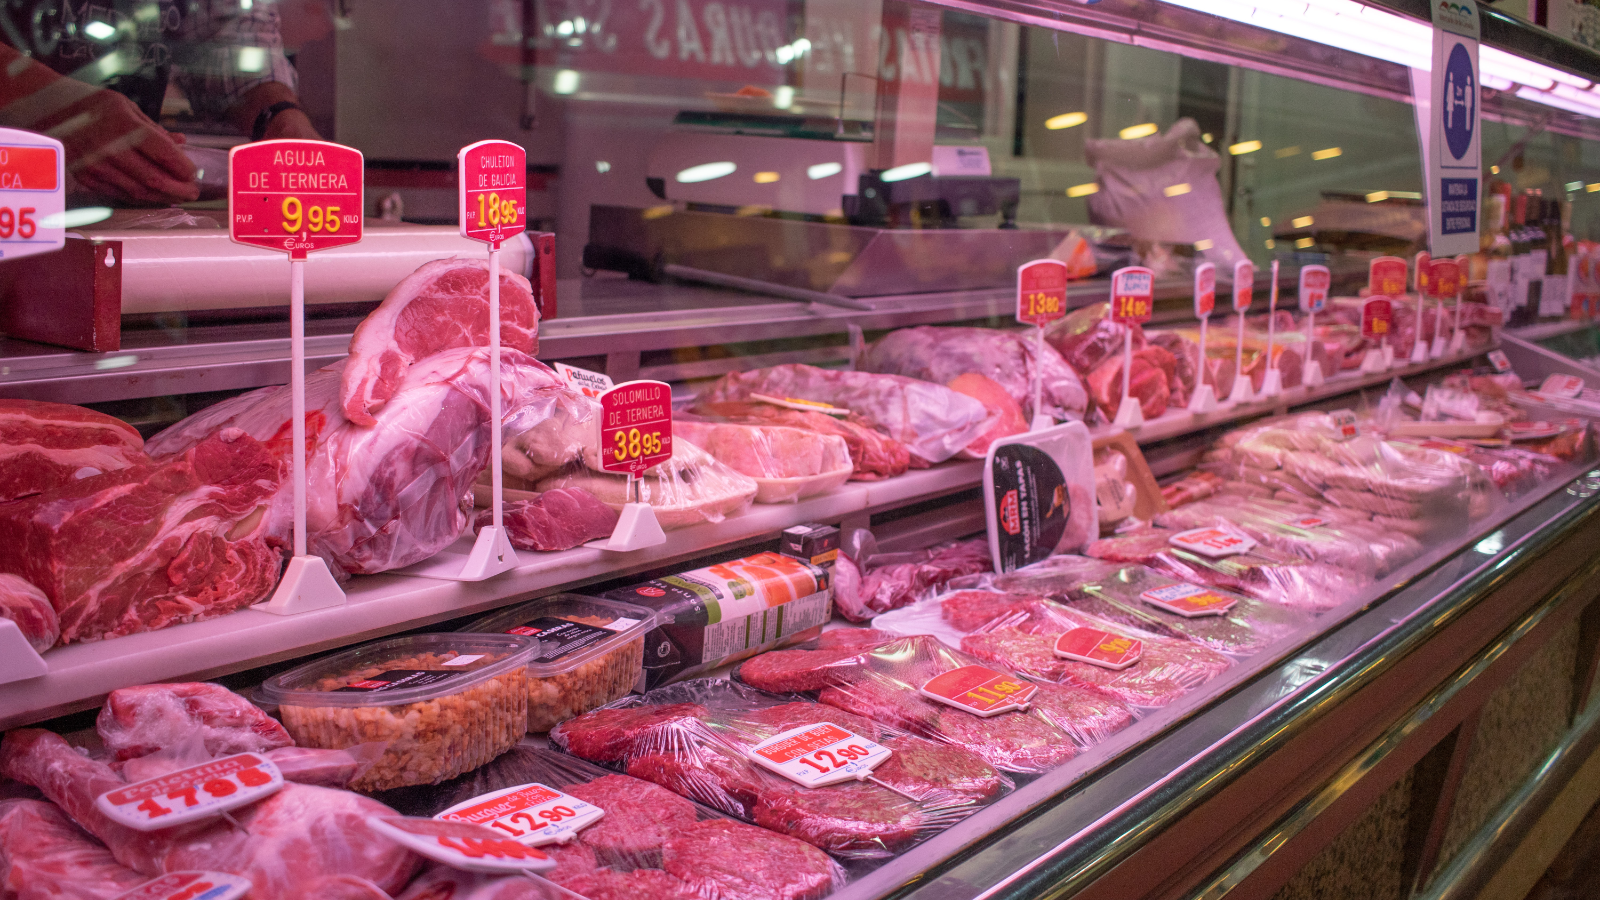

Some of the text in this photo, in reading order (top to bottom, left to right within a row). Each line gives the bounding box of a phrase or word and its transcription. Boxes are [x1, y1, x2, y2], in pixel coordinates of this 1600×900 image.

[273, 150, 325, 166] AGUJA
[480, 155, 515, 169] CHULETON
[249, 172, 348, 189] DE TERNERA
[478, 173, 517, 187] DE GALICIA
[343, 214, 359, 224] KILO
[612, 386, 661, 406] SOLOMILLO
[609, 405, 665, 426] DE TERNERA
[1007, 491, 1020, 533] MRM
[797, 733, 814, 742] DE
[808, 725, 833, 737] BUEY
[784, 735, 839, 759] CON SETAS
[449, 801, 518, 823] Burguer
[507, 792, 518, 803] de
